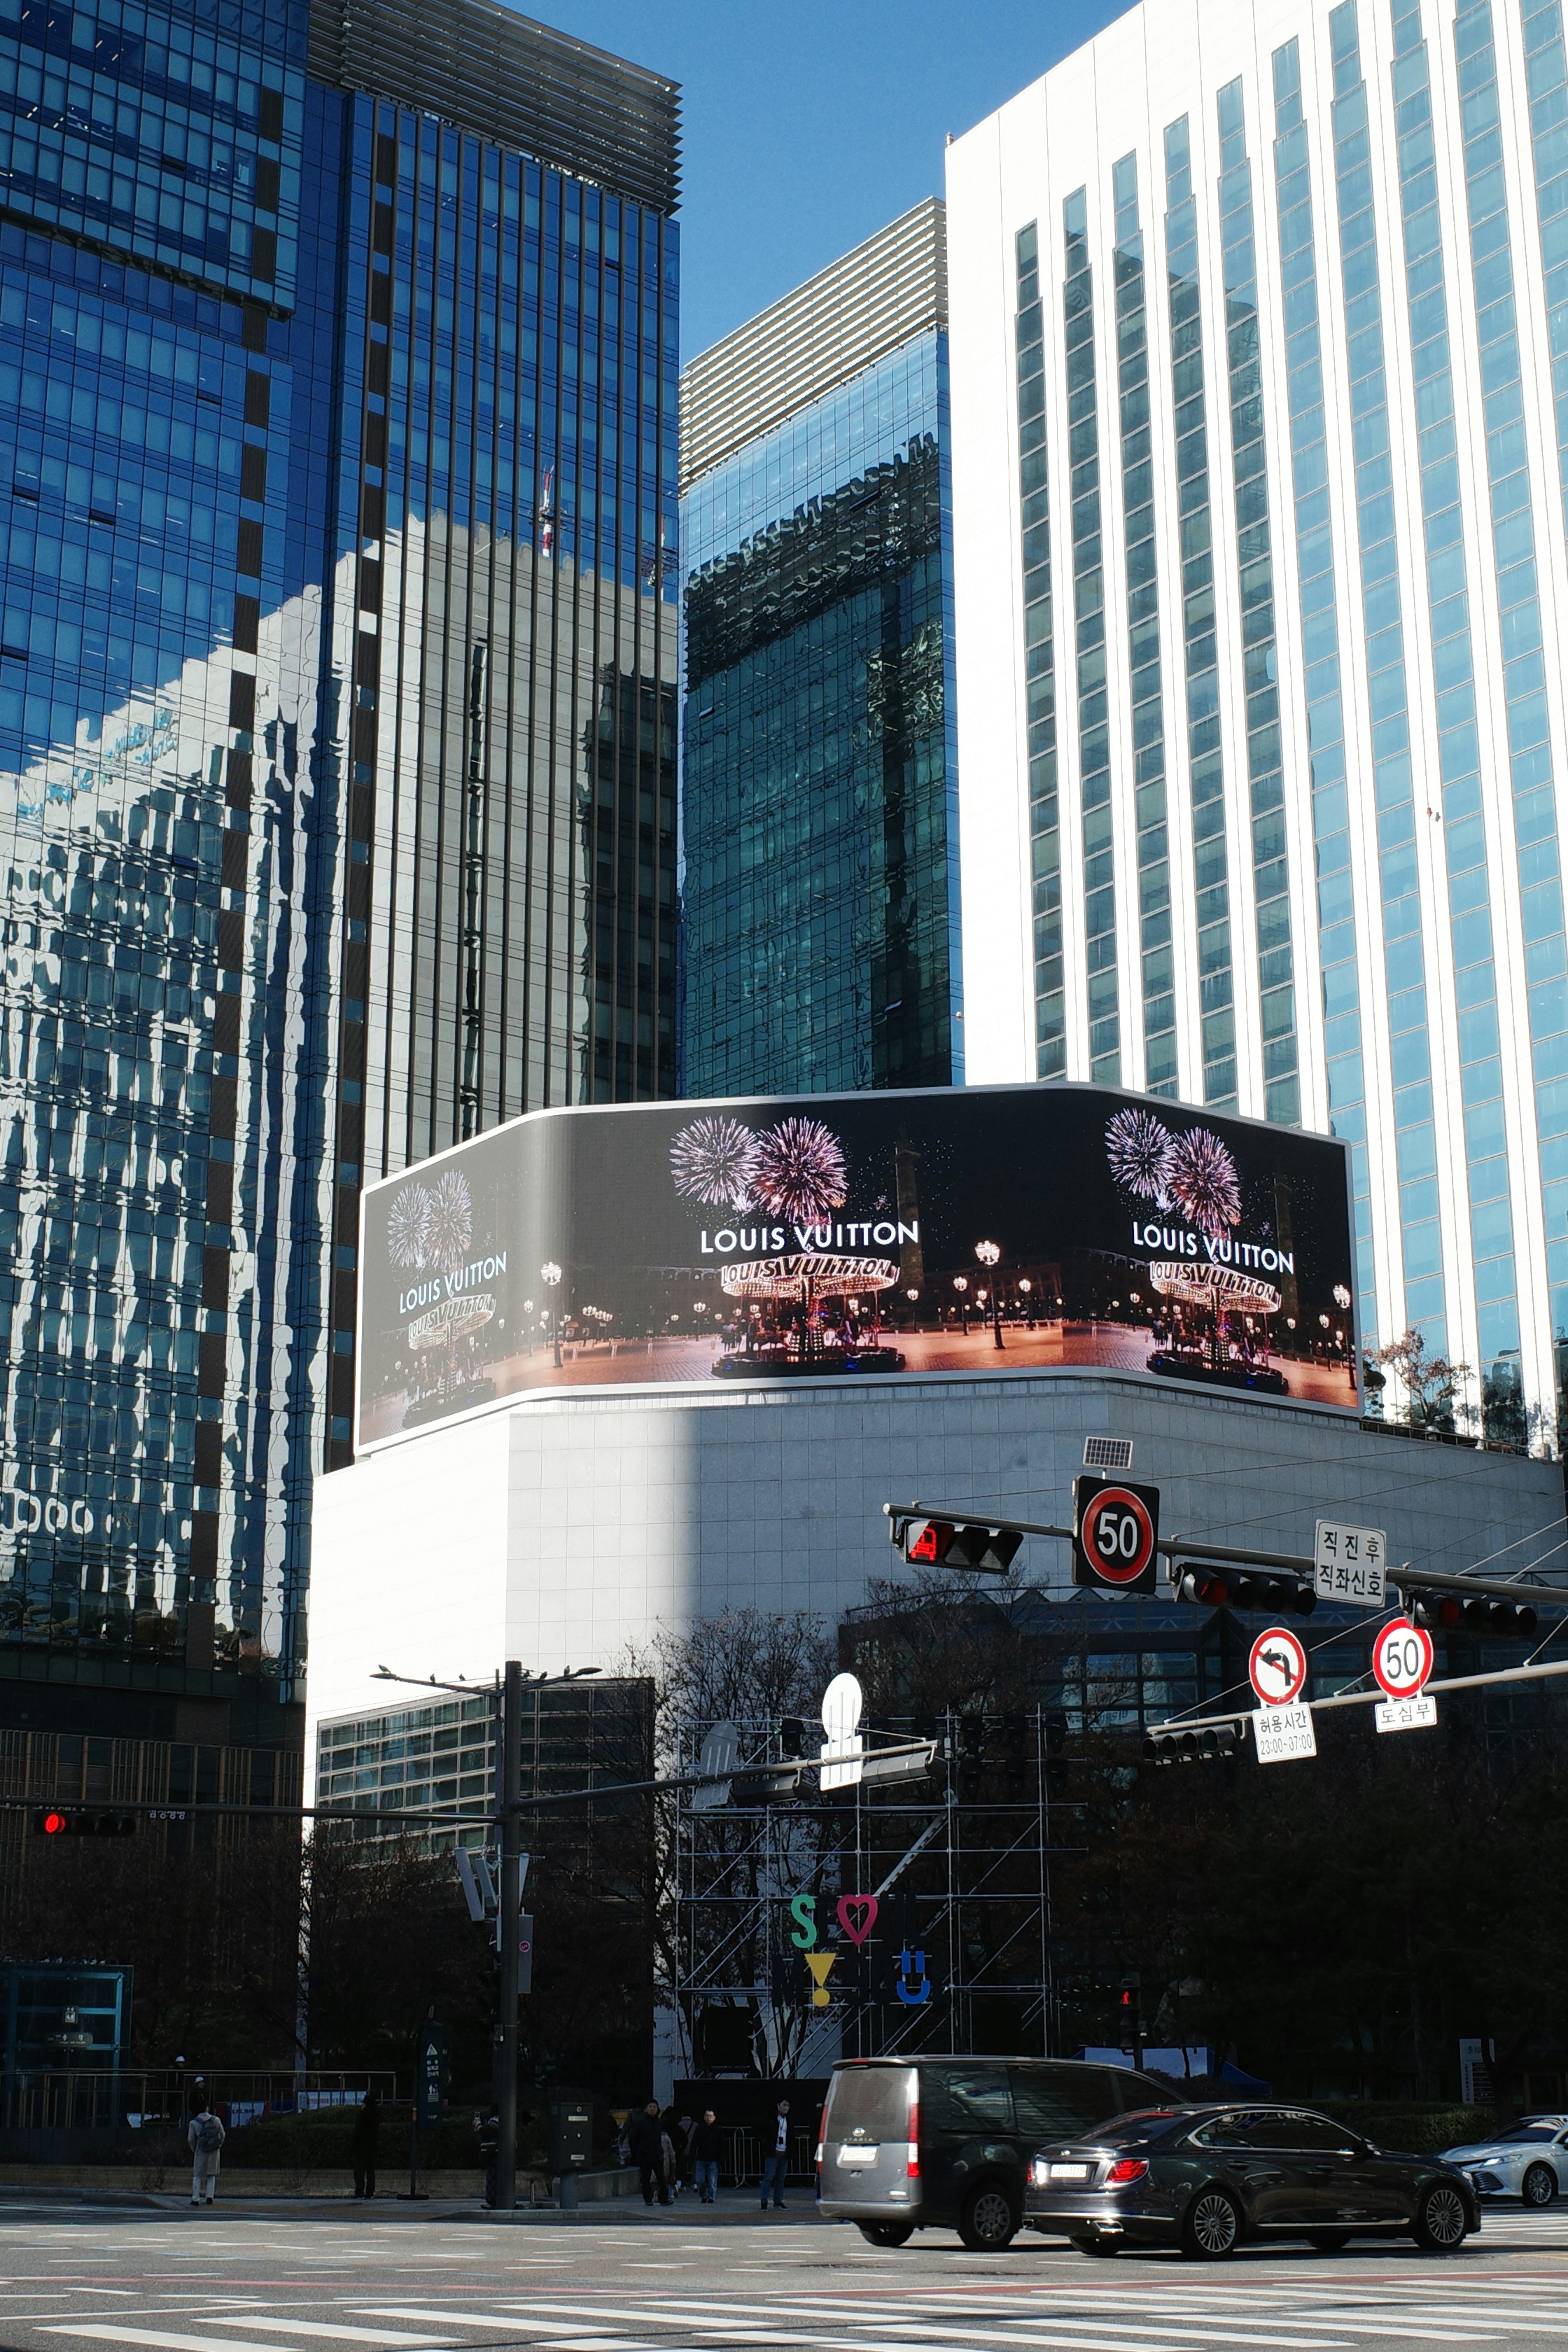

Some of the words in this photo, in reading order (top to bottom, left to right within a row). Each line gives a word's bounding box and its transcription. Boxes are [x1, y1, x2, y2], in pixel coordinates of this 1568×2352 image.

[701, 1227, 785, 1253] LOUIS
[794, 1221, 918, 1250] VUITTON
[1133, 1222, 1197, 1256] LOUIS
[1203, 1235, 1294, 1275] VUITTON
[400, 1279, 440, 1314] LOUIS
[444, 1251, 507, 1298] VUITTON
[721, 1259, 778, 1287] LOUIS
[780, 1255, 891, 1278] VUITTON
[1149, 1261, 1191, 1282] LOUIS
[1192, 1262, 1275, 1298] VUITTON
[409, 1309, 437, 1342] LOUIS
[437, 1294, 492, 1325] VUITTON
[1098, 1511, 1138, 1558] 50
[1319, 1564, 1382, 1597] 직좌신호
[1387, 1639, 1419, 1679] 50
[1380, 1702, 1431, 1723] 도심부
